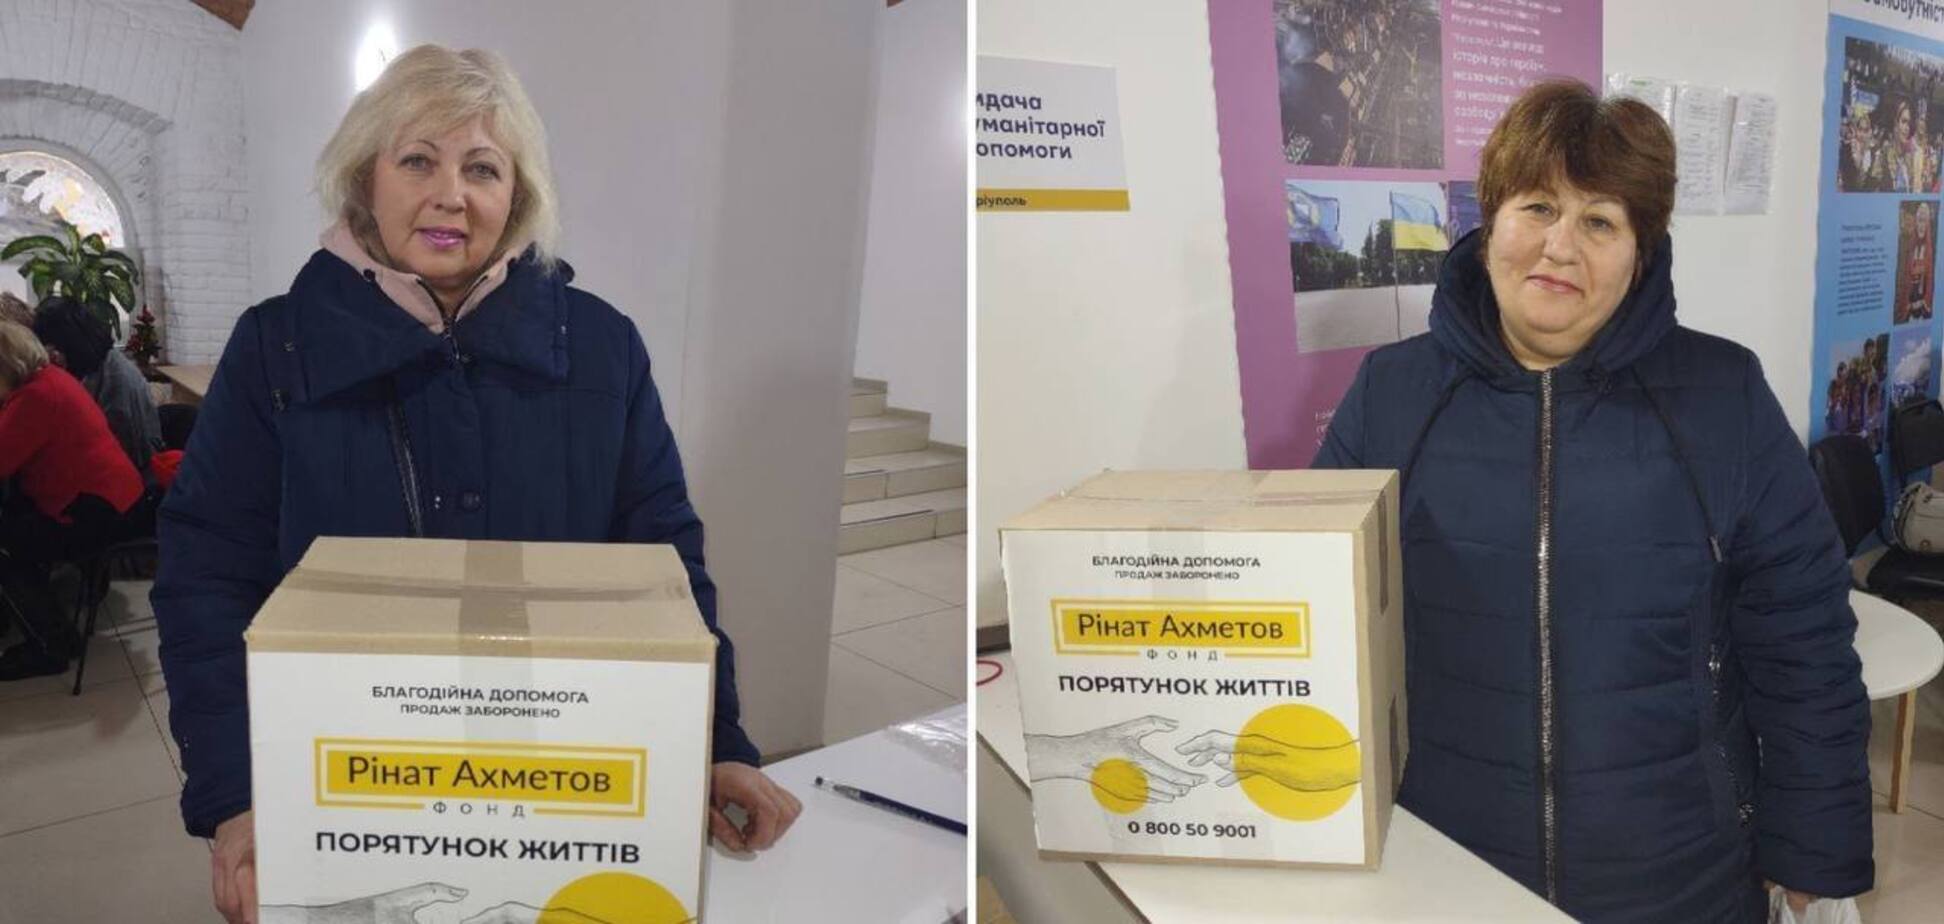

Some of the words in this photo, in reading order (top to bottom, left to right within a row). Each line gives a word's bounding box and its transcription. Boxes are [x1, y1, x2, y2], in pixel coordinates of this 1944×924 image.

[976, 116, 1105, 140] манітарної
[1092, 553, 1180, 569] БЛАГОДІЙНА
[1183, 556, 1261, 570] ДОПОМОГА
[1114, 570, 1163, 581] ПРОДАЖ
[1165, 571, 1240, 581] ЗАБОРОНЕНО
[1078, 613, 1151, 638] Рінат
[1159, 614, 1284, 640] Ахметов
[372, 685, 485, 702] БЛАГОДІЙНА
[489, 689, 590, 705] ДОПОМОГА
[1058, 675, 1208, 696] ПОРЯТУНОК
[1215, 679, 1311, 698] ЖИТТІВ
[400, 704, 462, 717] ПРОДАЖ
[464, 706, 561, 719] ЗАБОРОНЕНО
[347, 755, 441, 787] Рінат
[452, 759, 611, 794] Ахметов
[1128, 821, 1140, 833] 0
[1145, 821, 1181, 835] 800
[1185, 823, 1209, 837] 50
[1213, 824, 1256, 838] 9001
[315, 831, 509, 860] ПОРЯТУНОК
[517, 839, 641, 864] ЖИТТІВ
